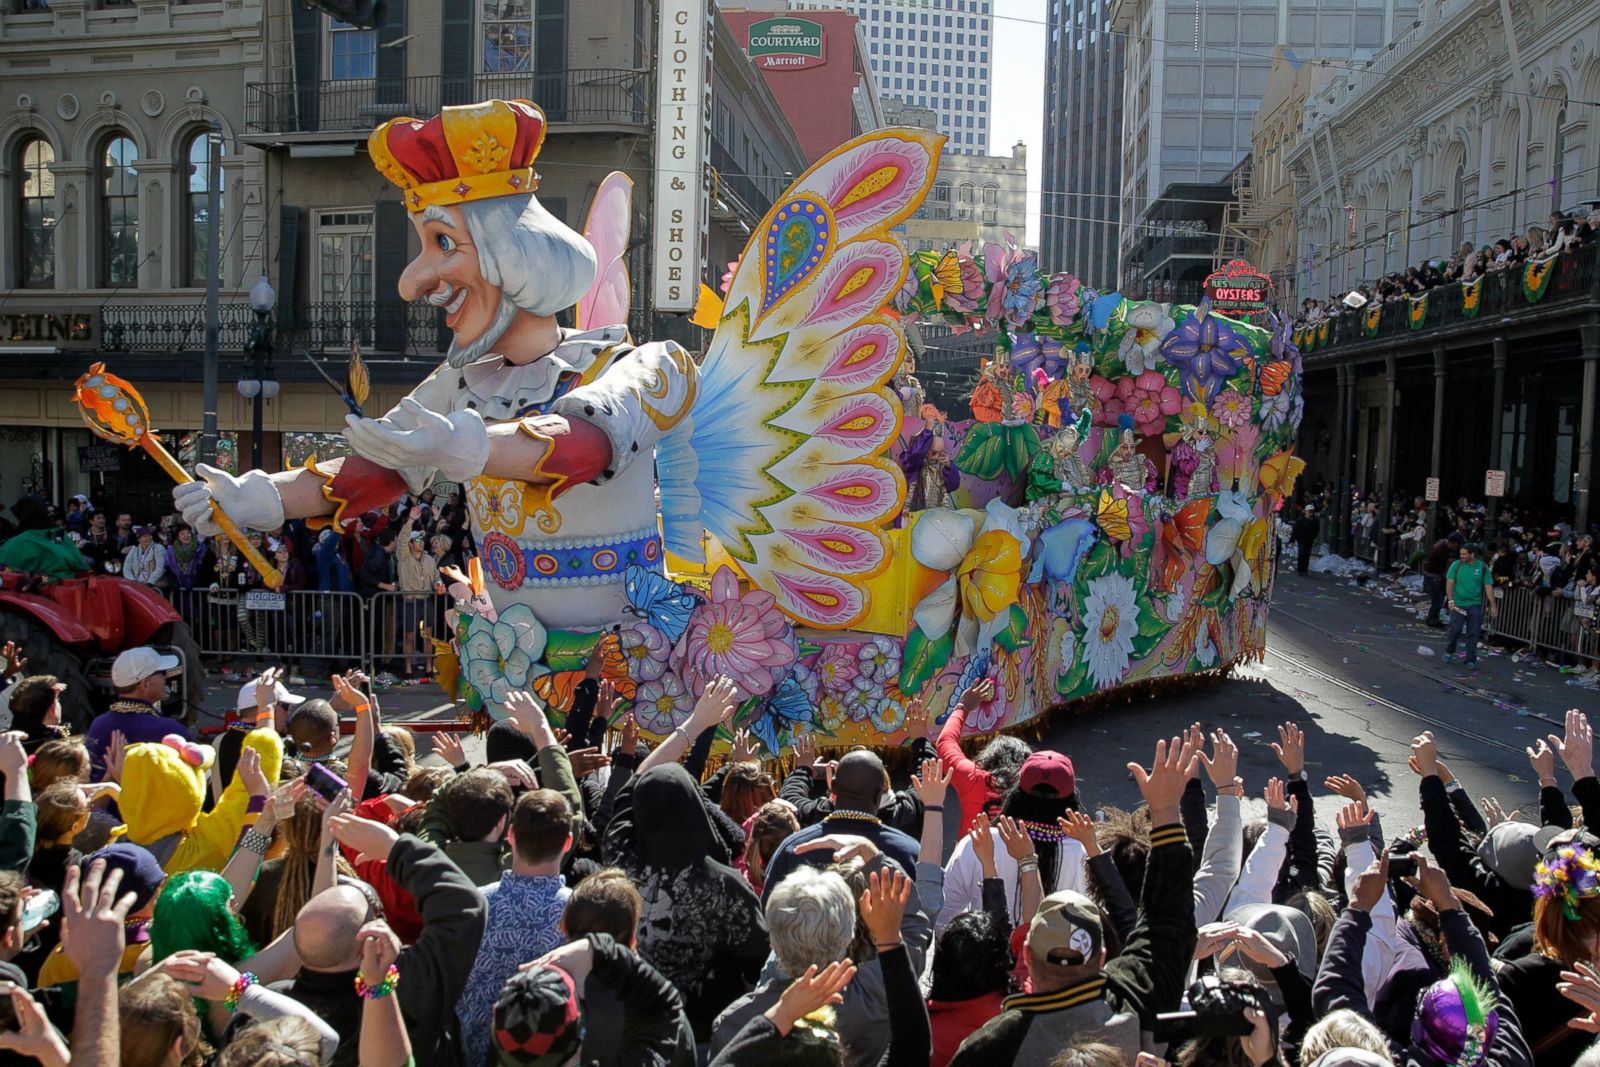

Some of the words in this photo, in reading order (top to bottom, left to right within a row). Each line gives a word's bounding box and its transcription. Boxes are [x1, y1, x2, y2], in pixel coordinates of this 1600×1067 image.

[750, 36, 820, 47] COURTYARD
[763, 56, 806, 67] Marriott
[671, 11, 688, 160] CLOTHING
[670, 176, 686, 191] &
[668, 209, 684, 301] SHOES
[1215, 288, 1261, 301] OYSTERS
